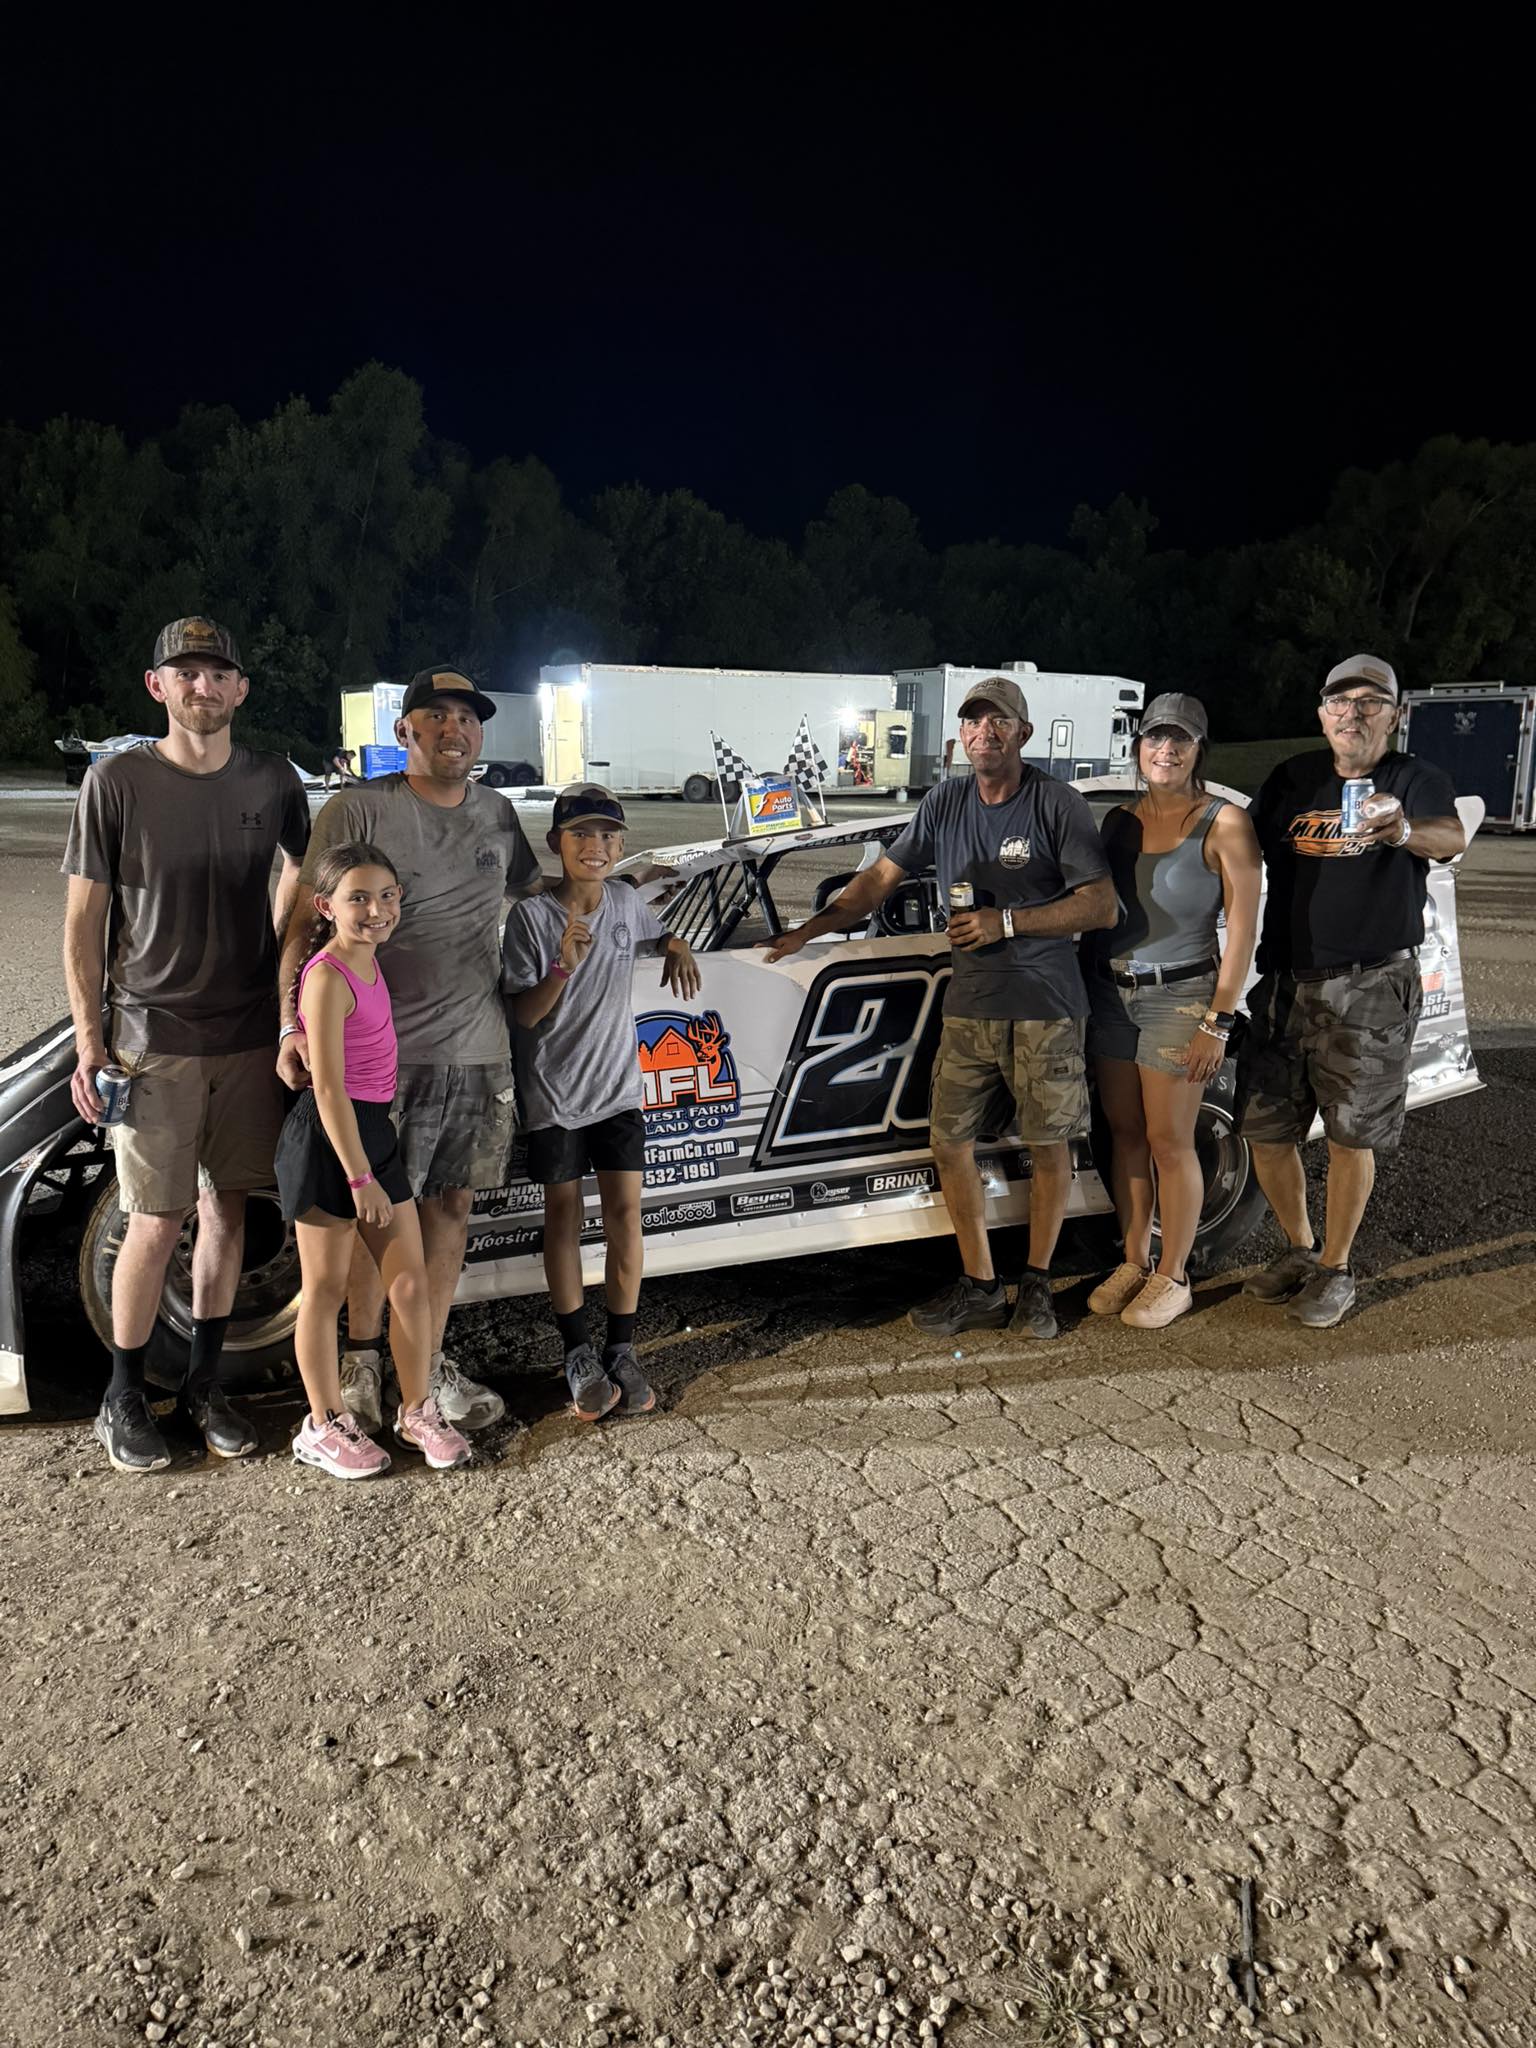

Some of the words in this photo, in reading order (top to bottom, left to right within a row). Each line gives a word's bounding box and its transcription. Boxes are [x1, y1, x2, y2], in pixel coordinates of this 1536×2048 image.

[771, 803, 793, 811] Parts
[773, 796, 792, 804] Auto
[1419, 1002, 1449, 1018] ANE
[689, 1103, 735, 1117] FARM
[645, 1121, 689, 1135] LAND
[694, 1117, 720, 1129] CO
[873, 1171, 928, 1192] BRINN
[736, 1191, 791, 1206] Beyea
[642, 1200, 717, 1228] wilwood
[466, 1229, 539, 1252] Hoosier
